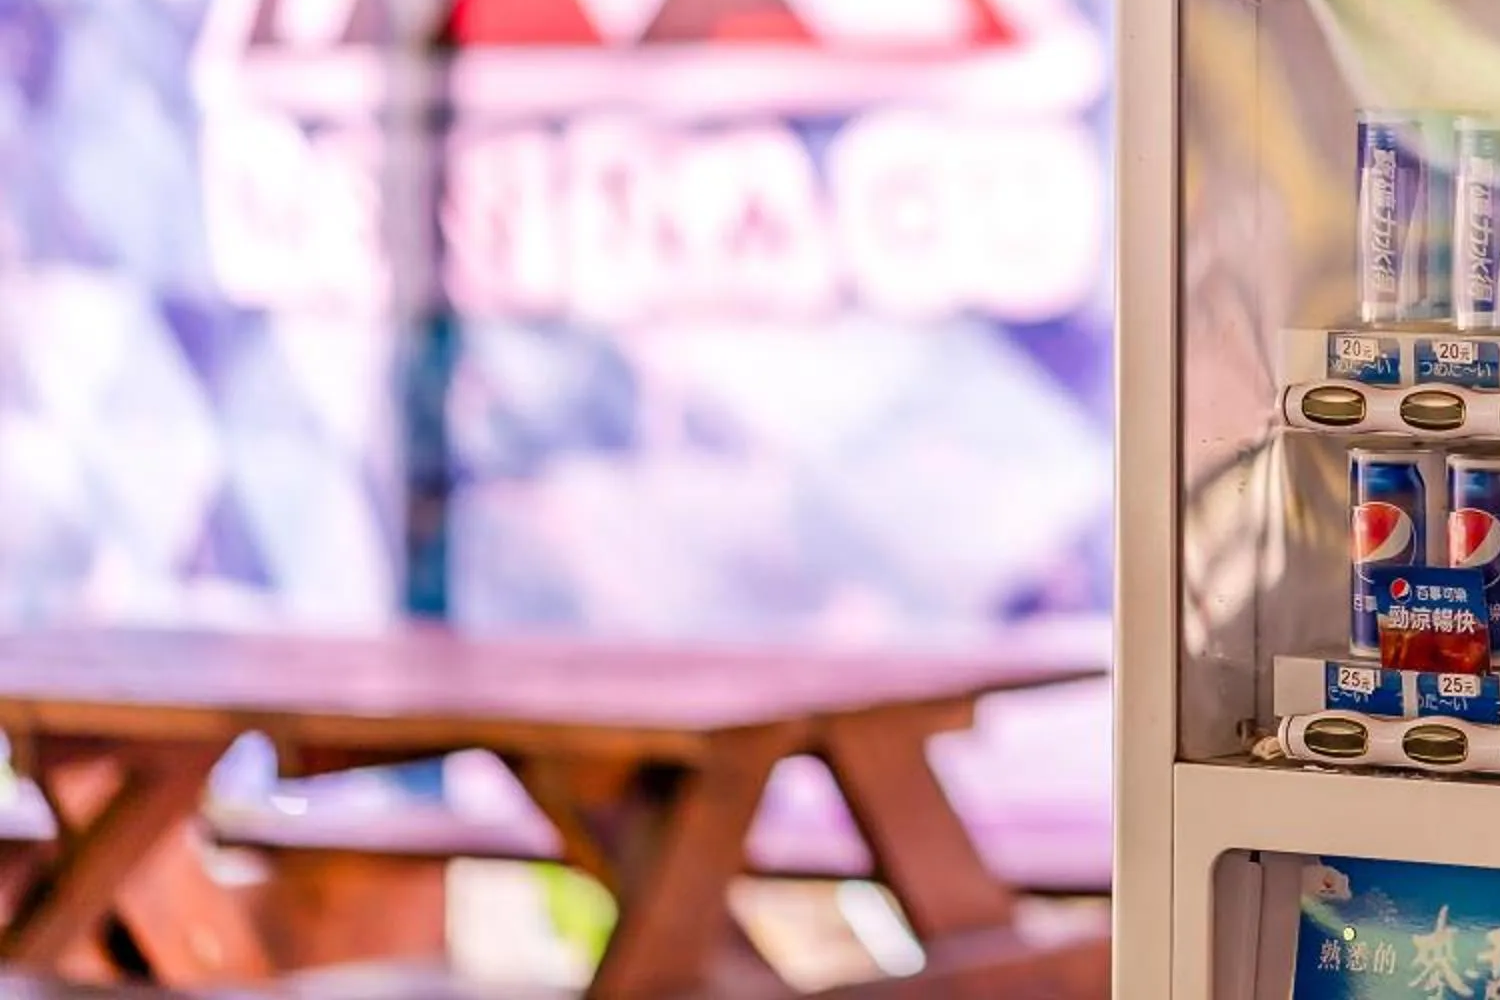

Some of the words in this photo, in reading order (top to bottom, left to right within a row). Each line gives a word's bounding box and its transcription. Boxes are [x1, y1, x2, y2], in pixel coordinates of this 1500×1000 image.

[1343, 339, 1372, 358] 20元
[1439, 343, 1471, 361] 20元
[1388, 605, 1476, 634] 勁涼暢快
[1341, 669, 1370, 690] 25元
[1443, 677, 1475, 694] 25元
